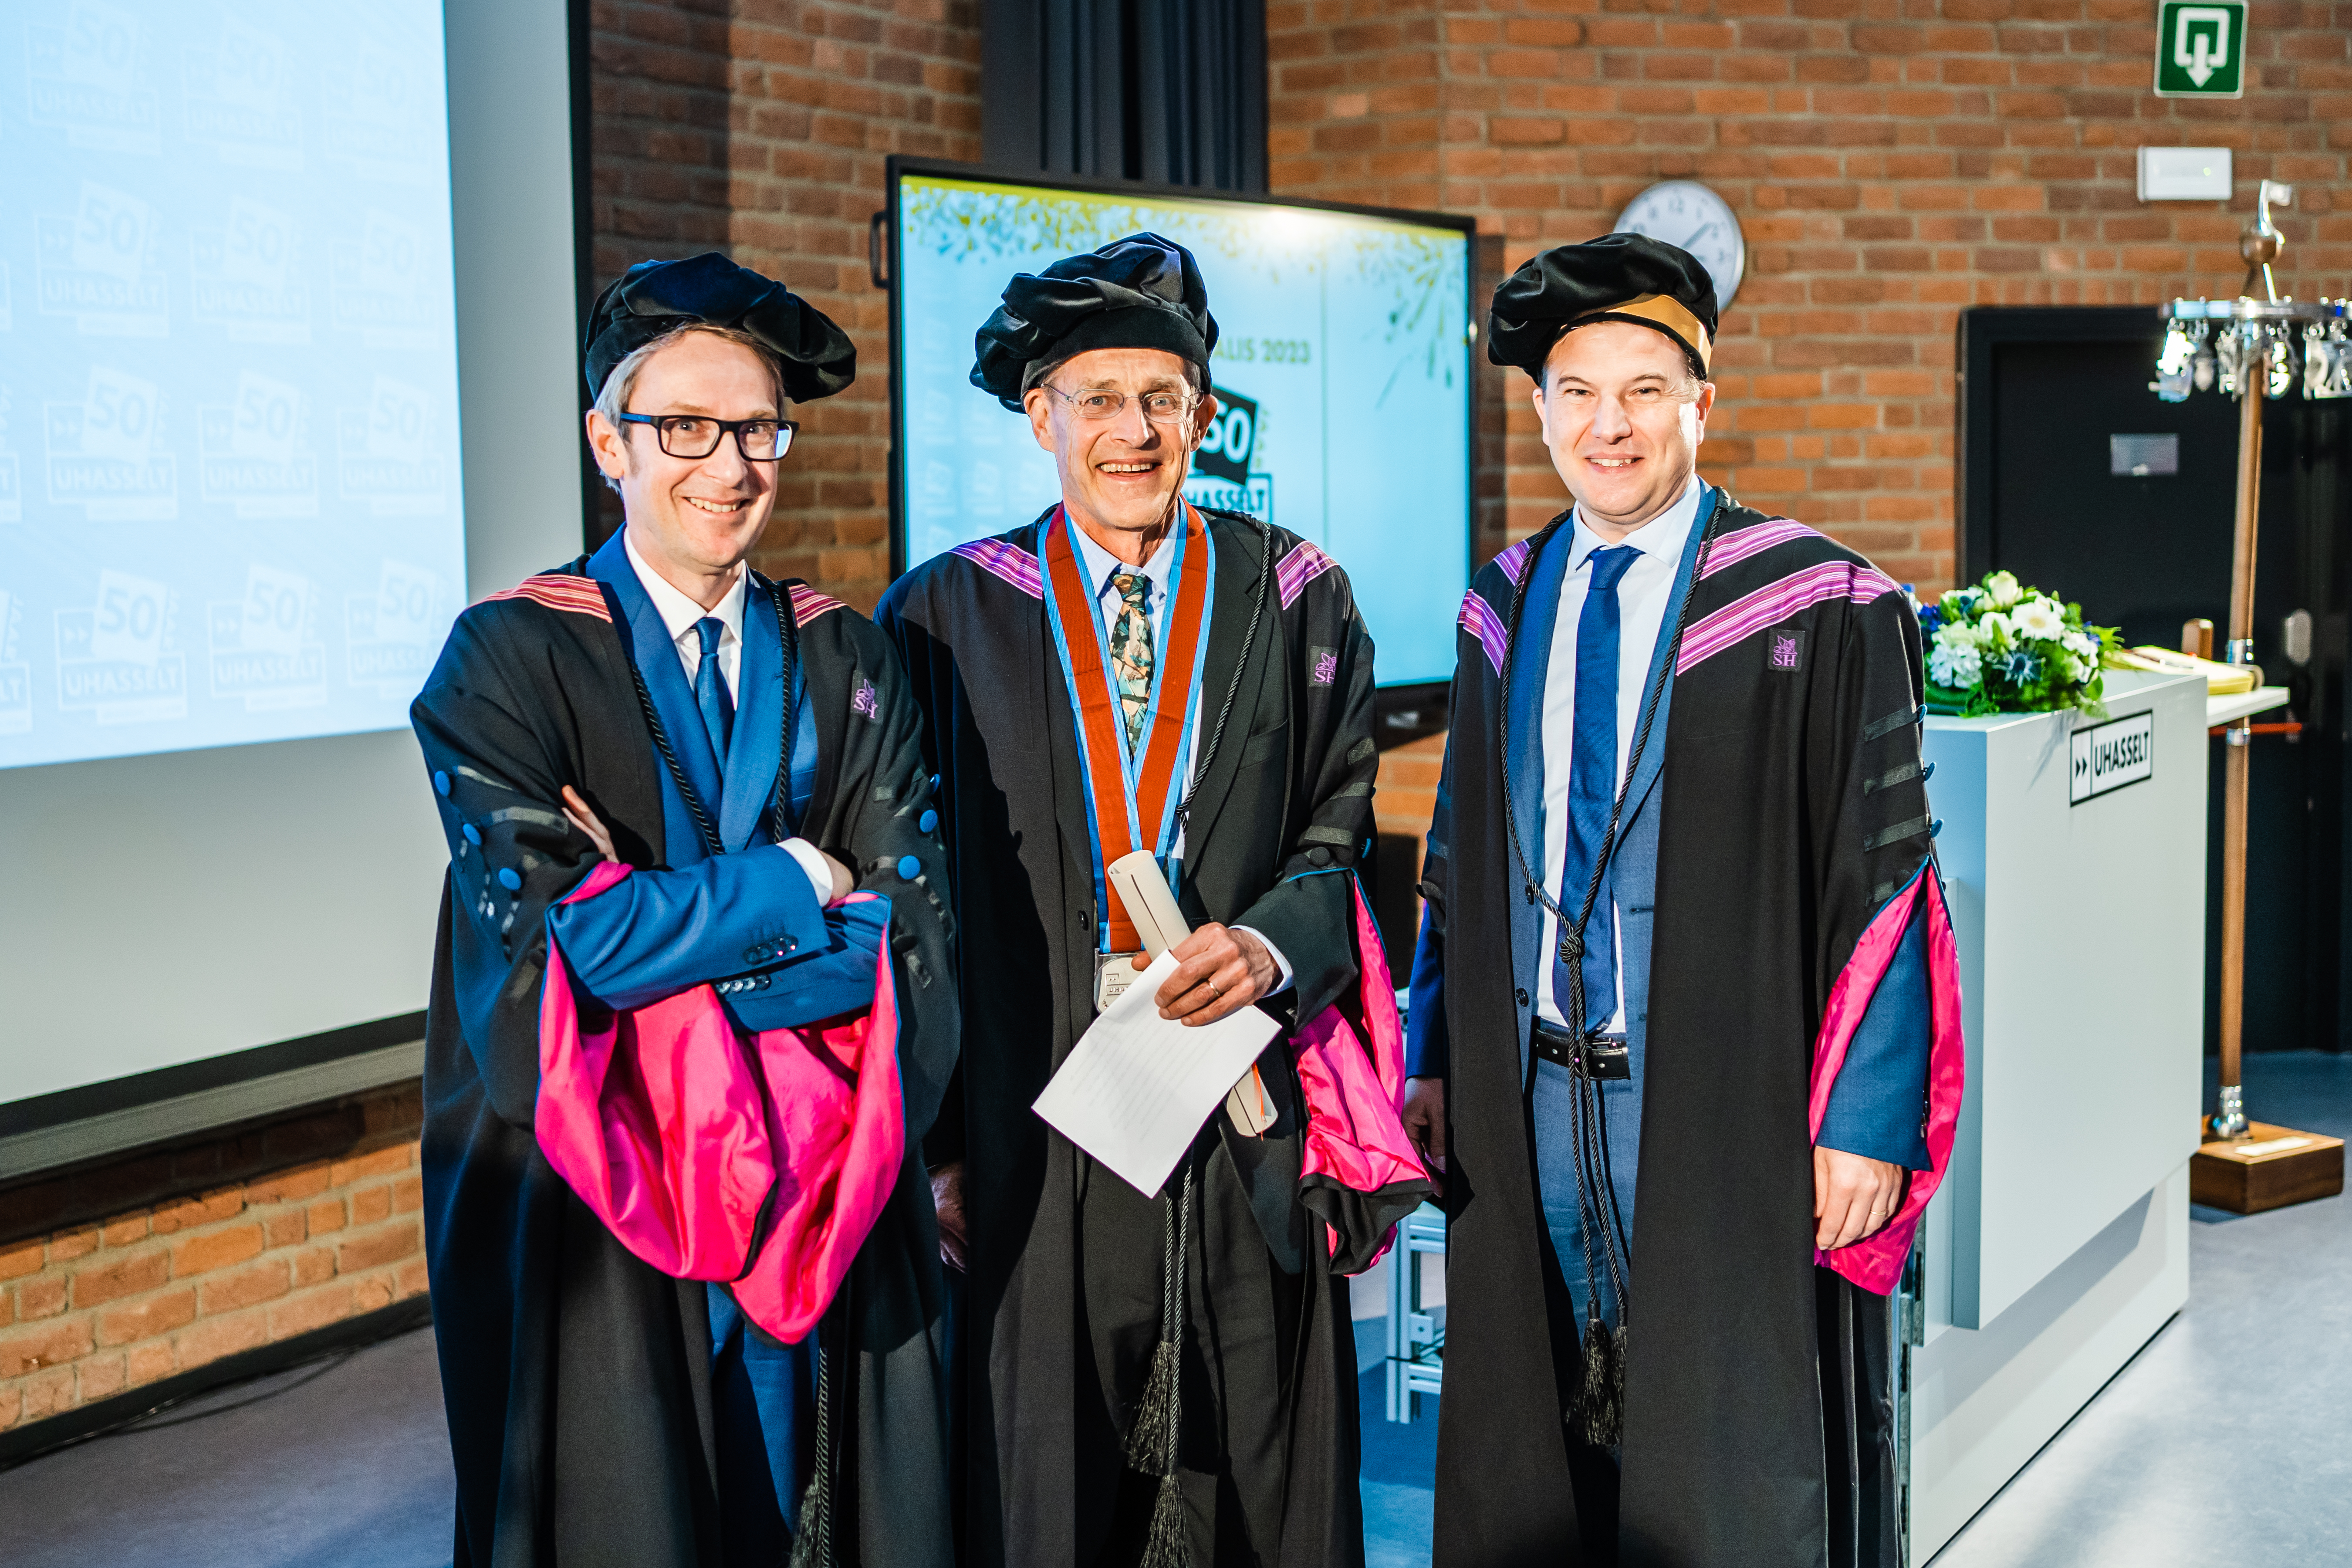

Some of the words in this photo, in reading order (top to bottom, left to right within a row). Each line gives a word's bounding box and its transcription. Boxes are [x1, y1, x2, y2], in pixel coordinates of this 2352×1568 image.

[70, 10, 131, 69] 50
[36, 88, 150, 124] UHASSELT
[80, 197, 140, 256] 50
[232, 210, 283, 265] 50
[46, 278, 160, 307] UHASSELT
[1213, 338, 1254, 361] ALIS
[1263, 339, 1311, 363] 2023
[89, 382, 147, 438] 50
[239, 388, 291, 439] 50
[373, 391, 421, 441] 50
[1200, 400, 1251, 463] 50
[55, 466, 169, 491] UHASSELT
[208, 465, 310, 489] UHASSELT
[1186, 489, 1264, 511] HASSELT
[99, 586, 158, 642] 50
[247, 580, 299, 631] 50
[381, 577, 429, 623] 50
[65, 666, 179, 697] UHASSELT
[218, 656, 318, 685] UHASSELT
[354, 648, 432, 674] UHASSE
[1773, 654, 1796, 666] SH
[2095, 731, 2149, 776] UHASSELT
